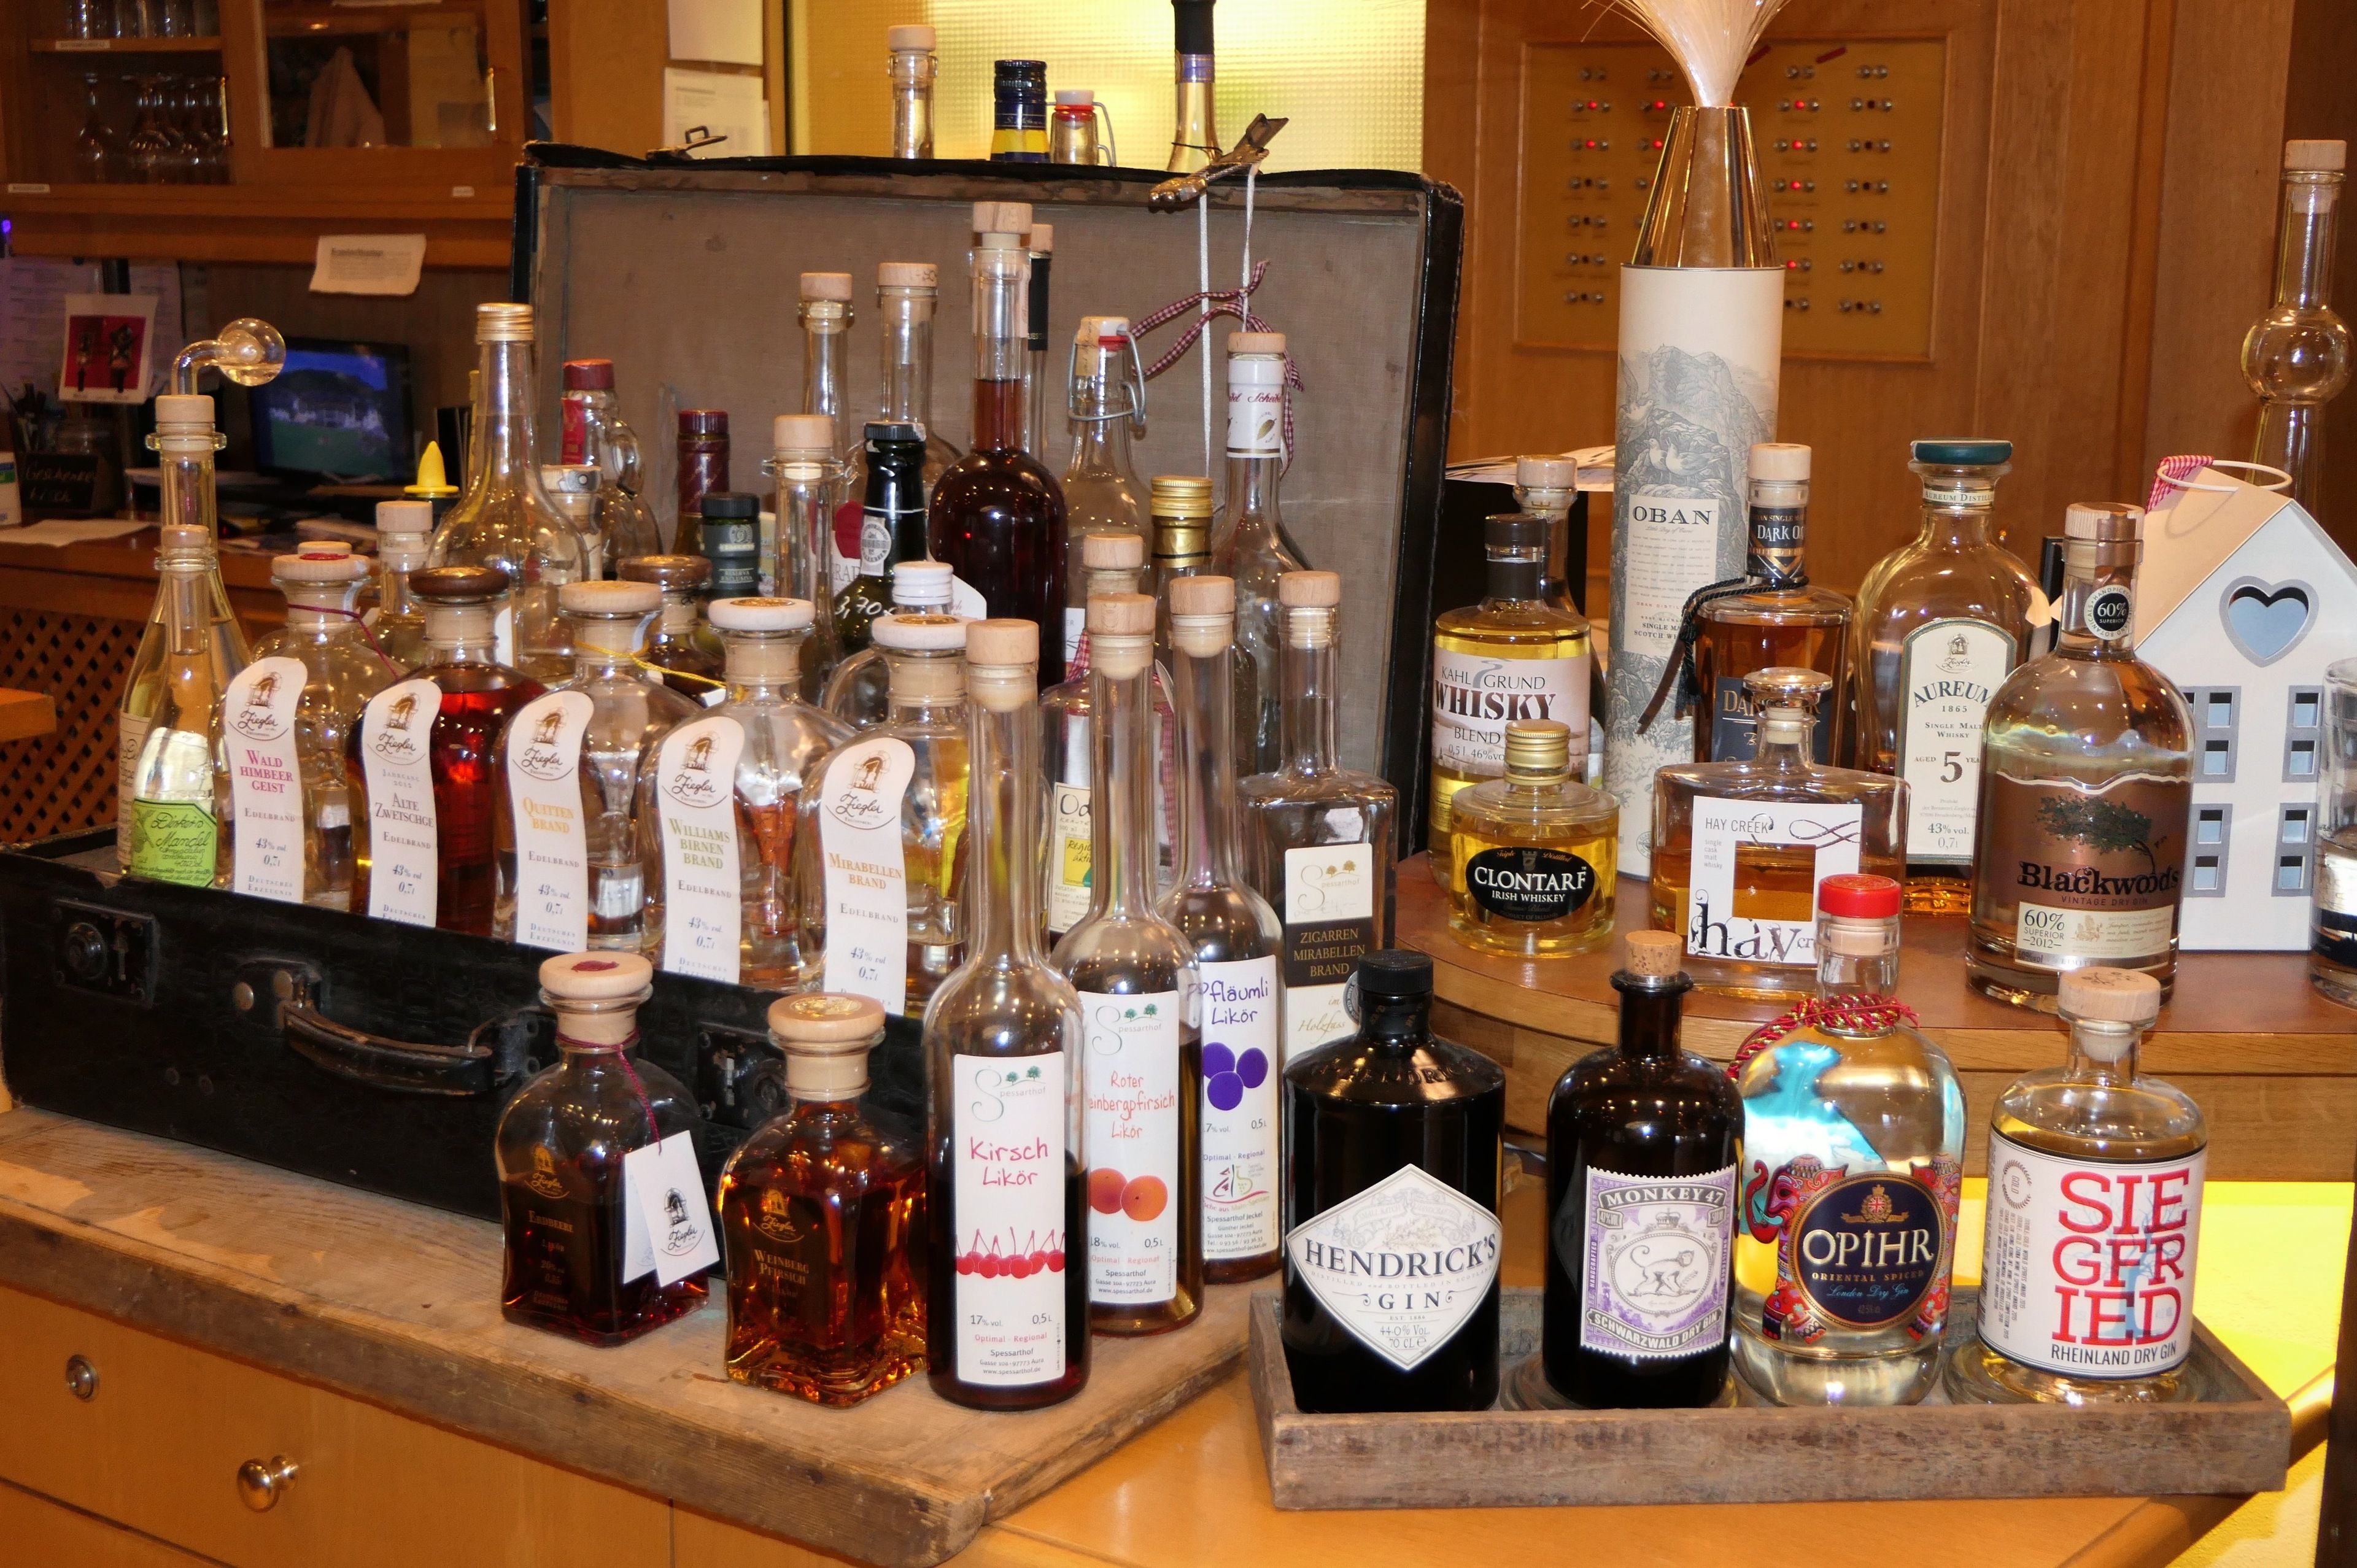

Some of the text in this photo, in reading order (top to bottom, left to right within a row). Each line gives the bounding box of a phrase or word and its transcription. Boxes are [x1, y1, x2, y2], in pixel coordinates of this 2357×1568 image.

[1925, 491, 1956, 501] AUREUM
[1632, 506, 1713, 525] OBAN
[1757, 525, 1790, 542] DARK
[2097, 603, 2126, 617] 60%
[1634, 630, 1663, 639] SCOTCH
[1442, 666, 1546, 690] KAHL GRUND
[1434, 679, 1557, 720] WHISKY
[1913, 681, 1992, 708] AUREUM
[238, 708, 278, 731] Ziegler
[376, 730, 416, 755] Ziegler
[1454, 727, 1501, 744] BLEND
[246, 749, 282, 767] WALD
[522, 745, 563, 770] Ziegler
[240, 766, 293, 781] HIMBEER
[1940, 751, 1963, 783] 5
[252, 779, 285, 794] GEIST
[671, 771, 716, 797] Ziegler
[392, 792, 420, 811] ALTE
[524, 797, 575, 819] QUITTEN
[835, 791, 884, 817] Ziegler
[245, 808, 295, 822] EDELBRAND
[375, 802, 434, 828] ZWETSCHGE
[532, 818, 570, 834] BRAND
[669, 817, 730, 843] WILLIAMS
[1705, 817, 1768, 833] HAY CREEK
[1927, 823, 1951, 833] 43%
[156, 831, 212, 847] Mandel
[256, 838, 274, 850] 43%
[383, 831, 431, 849] EDELBRAND
[680, 838, 724, 855] BIRNEN
[528, 850, 580, 868] EDELBRAND
[683, 852, 724, 870] BRAND
[1542, 850, 1573, 862] Distilled
[393, 864, 411, 878] 43%
[829, 852, 902, 879] MIRABELLEN
[848, 874, 886, 889] BRAND
[1474, 866, 1587, 891] CLONTARF
[2017, 861, 2179, 895] Blackwoods
[678, 879, 732, 898] EDELBRAND
[1492, 890, 1566, 902] IRISH WHISKEY
[2061, 896, 2106, 906] VINTAGE
[840, 903, 899, 923] EDELBRAND
[2024, 910, 2065, 931] 60%
[1300, 928, 1359, 944] ZIGARREN
[2024, 927, 2064, 940] SUPERIOR
[850, 947, 873, 962] 43%
[1293, 944, 1365, 961] MIRABELLEN
[1310, 963, 1349, 977] BRAND
[1212, 1008, 1258, 1025] Likör
[1298, 1011, 1345, 1044] Holzfass
[1111, 1070, 1144, 1087] Roter
[1089, 1089, 1175, 1121] einbergpfirsich
[1111, 1121, 1142, 1138] Likör
[970, 1137, 1048, 1161] Kirsch
[1203, 1149, 1265, 1161] Optimal Regional
[983, 1167, 1038, 1186] Likör
[1607, 1188, 1725, 1207] MONKEY 47
[2059, 1167, 2189, 1235] SIE
[1246, 1211, 1263, 1220] Jeckel
[668, 1228, 697, 1250] Ziegler
[1803, 1229, 1934, 1267] OPIHR
[754, 1249, 809, 1273] WEINBERG
[1091, 1255, 1159, 1265] Optimal Regional
[1304, 1233, 1497, 1279] HENDRICK'S
[1589, 1242, 1597, 1288] HANDCRAFTED
[2053, 1234, 2185, 1288] GFR
[759, 1262, 806, 1284] PFIRSICH
[1105, 1269, 1146, 1277] Spessarthof
[1311, 1271, 1363, 1286] DISTILLED
[1812, 1270, 1924, 1282] ORIENTAL SPICED
[1379, 1291, 1441, 1310] GIN
[1827, 1283, 1909, 1300] London Dry Gin
[970, 1315, 989, 1326] 17%
[2051, 1285, 2181, 1346] IED
[975, 1332, 1047, 1343] Optimal Regional
[1595, 1311, 1718, 1348] SCHWARZWALD DRY GIN
[1389, 1338, 1414, 1348] 70 CL
[991, 1348, 1034, 1357] Spessarthof
[2051, 1340, 2177, 1365] RHEINLAND DRY GIN
